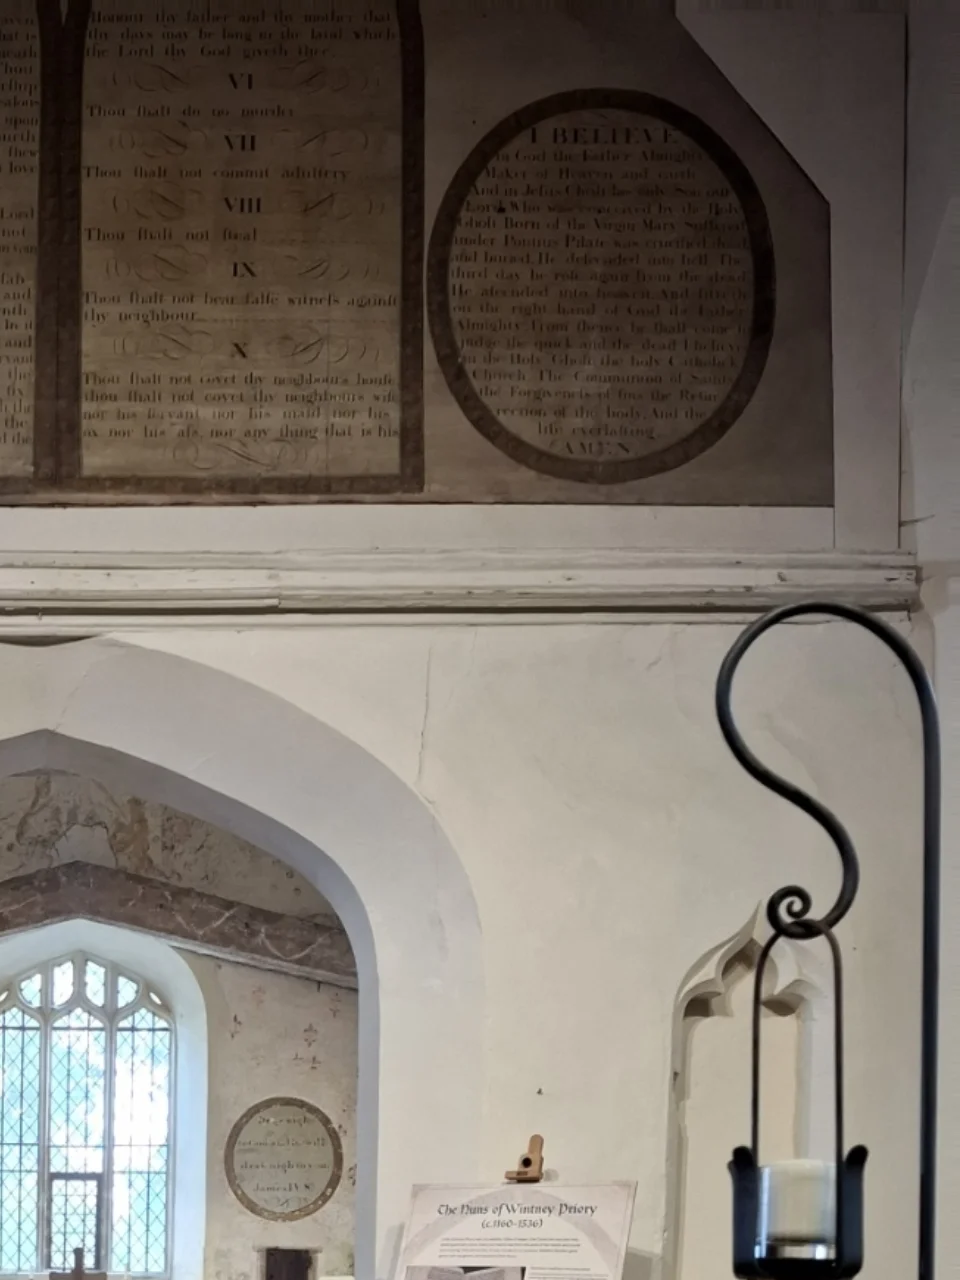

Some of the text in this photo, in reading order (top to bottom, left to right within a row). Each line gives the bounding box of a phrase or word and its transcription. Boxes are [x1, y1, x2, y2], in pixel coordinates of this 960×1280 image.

[86, 45, 109, 58] the
[118, 45, 154, 57] Lord
[165, 46, 187, 59] thy
[200, 46, 231, 57] God
[228, 73, 253, 90] VI
[86, 105, 125, 117] Thou
[182, 105, 201, 116] do
[224, 135, 256, 151] VII
[83, 166, 122, 178] Thou
[180, 168, 202, 178] not
[224, 197, 261, 213] VIII
[84, 228, 209, 241] Thou not
[232, 262, 257, 277] IX
[83, 292, 120, 304] Thou
[172, 292, 195, 304] not
[84, 310, 109, 323] thy
[231, 342, 247, 358] X
[83, 373, 120, 385] Thou
[170, 374, 191, 385] not
[172, 391, 194, 403] not
[437, 1203, 598, 1217] The Nuns of Wintney Priory
